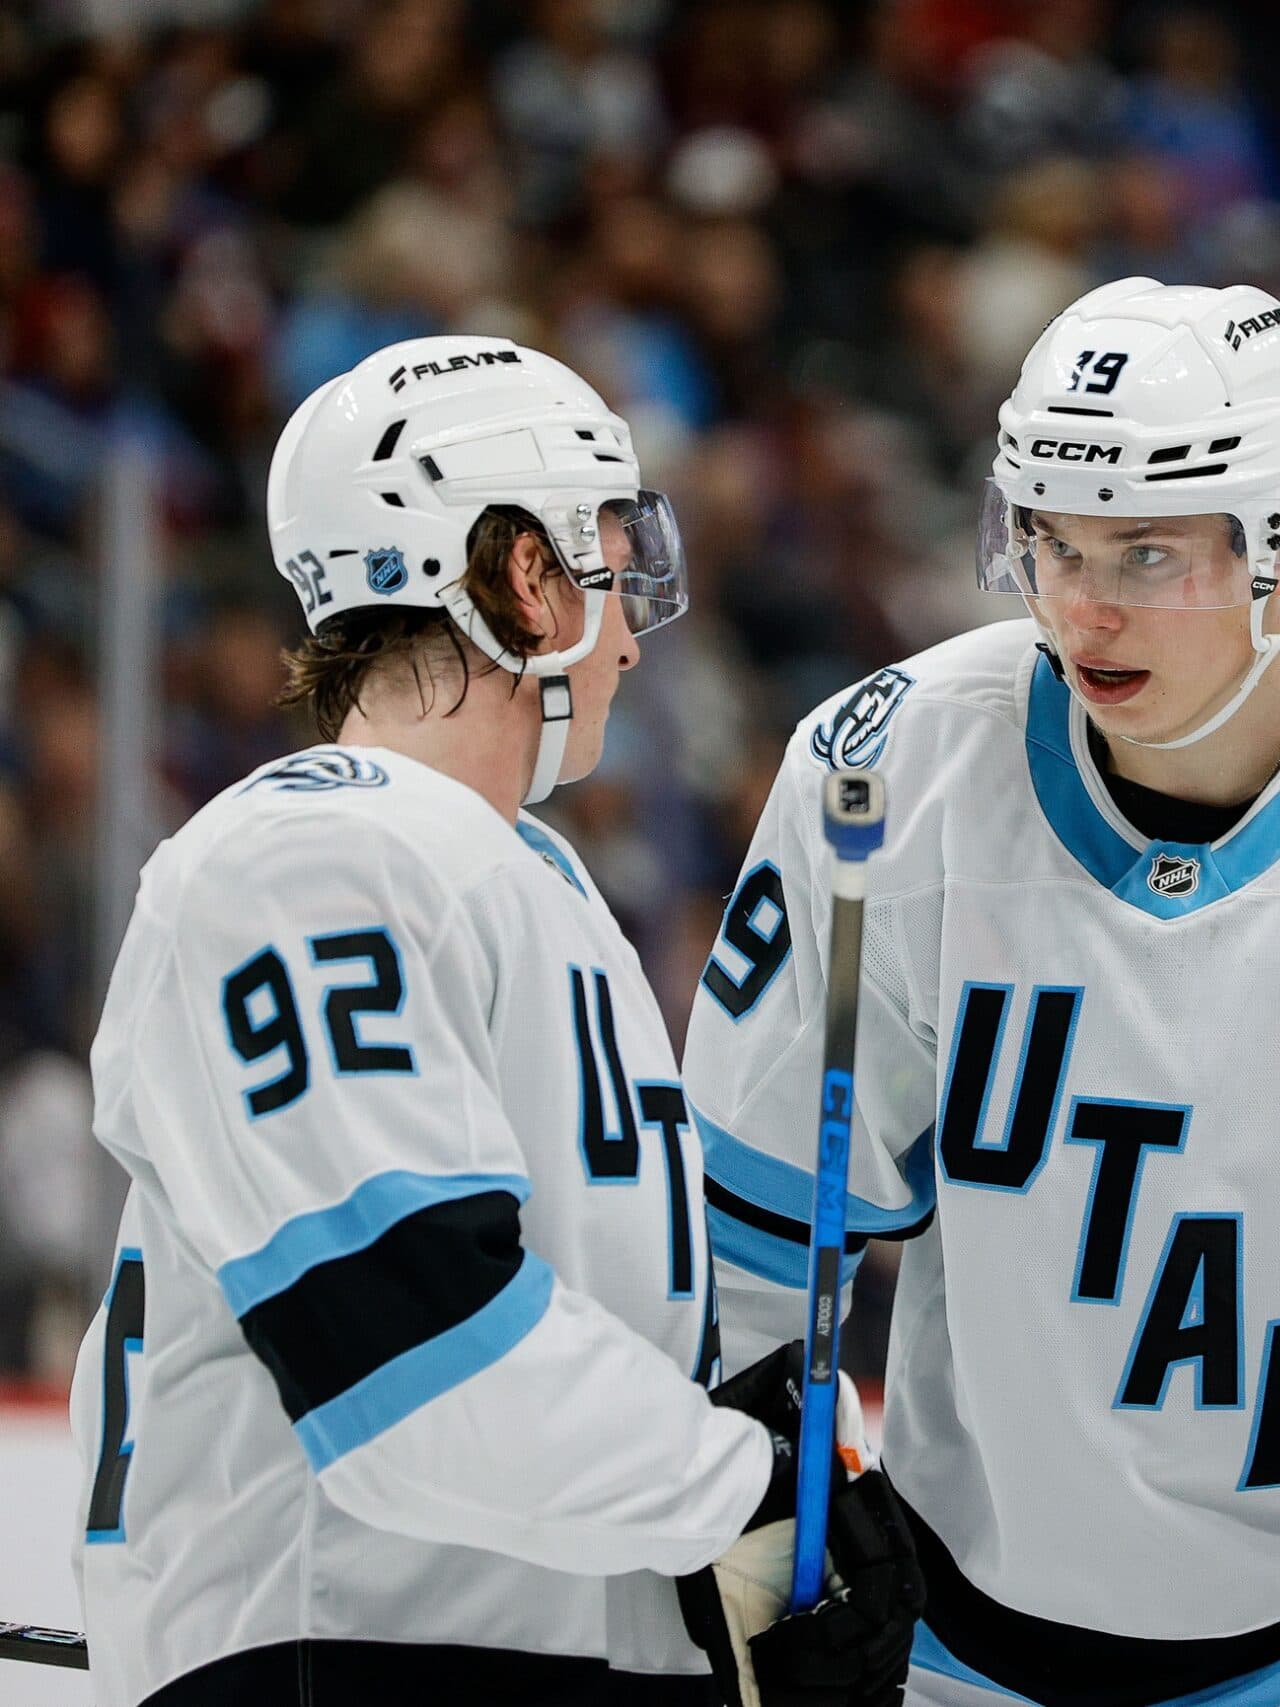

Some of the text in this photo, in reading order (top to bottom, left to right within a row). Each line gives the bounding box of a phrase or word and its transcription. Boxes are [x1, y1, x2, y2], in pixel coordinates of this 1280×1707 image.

[412, 351, 521, 380] FILEVINE
[1066, 350, 1129, 395] 19
[1030, 439, 1122, 464] CCM
[374, 555, 399, 586] NHL
[580, 570, 612, 587] CCM
[1252, 581, 1275, 591] CCM
[1158, 868, 1191, 889] NHL
[221, 925, 420, 1123] 92
[815, 1068, 852, 1213] CCM
[786, 1378, 803, 1410] CC
